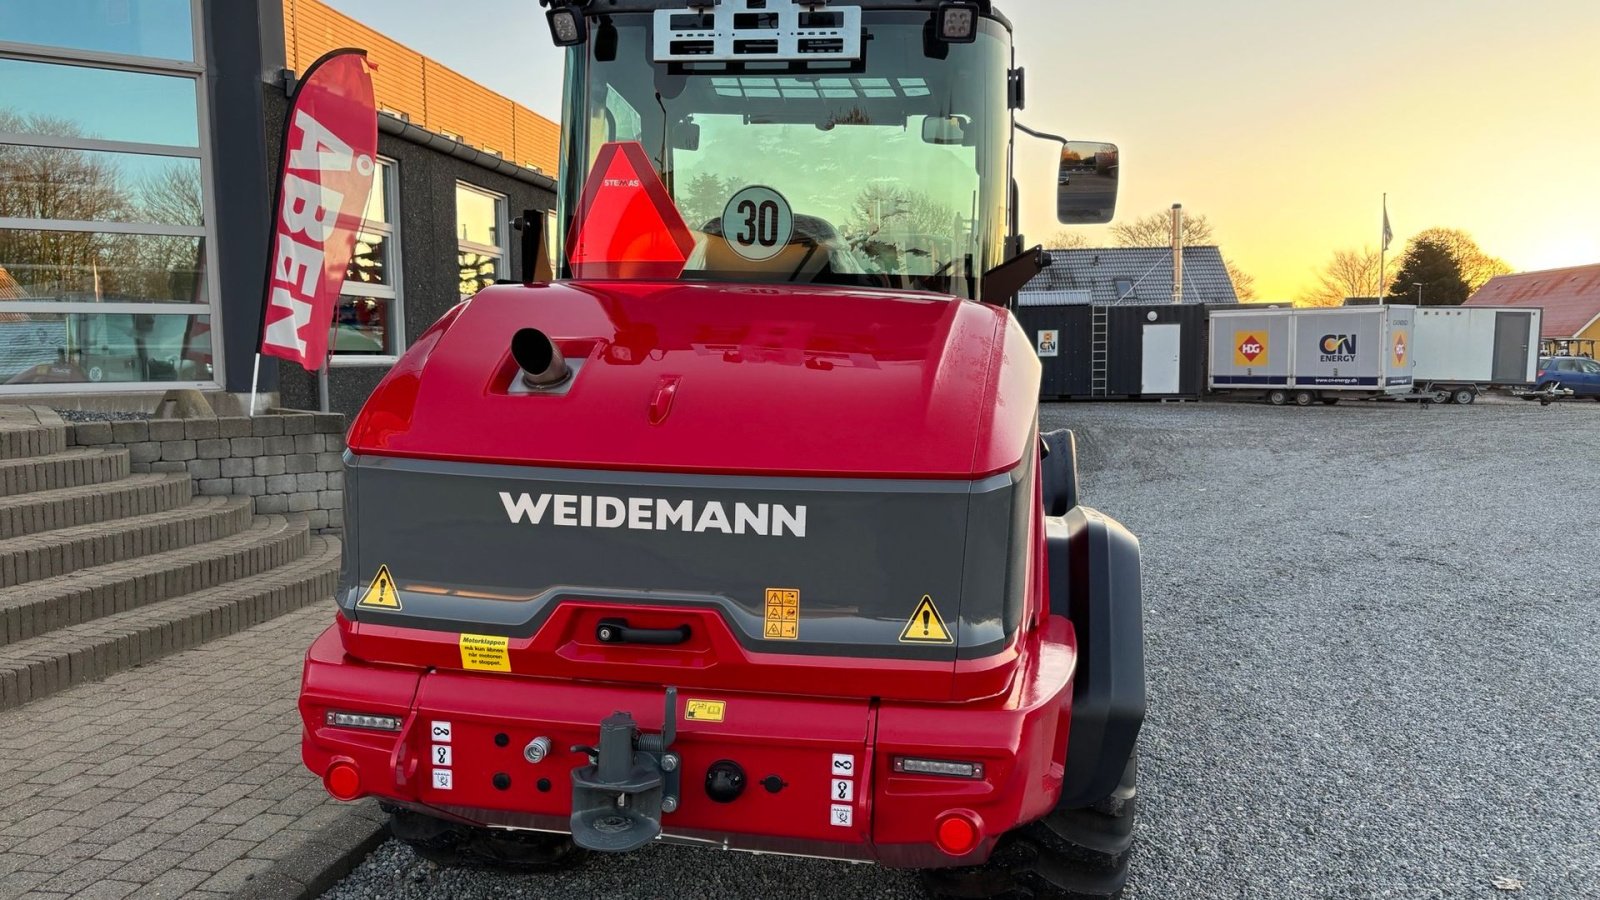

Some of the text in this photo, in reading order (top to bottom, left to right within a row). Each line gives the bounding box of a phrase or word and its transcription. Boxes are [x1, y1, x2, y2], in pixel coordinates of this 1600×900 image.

[265, 108, 375, 359] ÅBEN
[736, 199, 779, 247] 30
[1040, 341, 1055, 350] CN
[1242, 344, 1260, 354] HDG
[1319, 334, 1357, 355] CN
[498, 491, 807, 538] WEIDEMANN
[463, 637, 505, 645] Motorklappen
